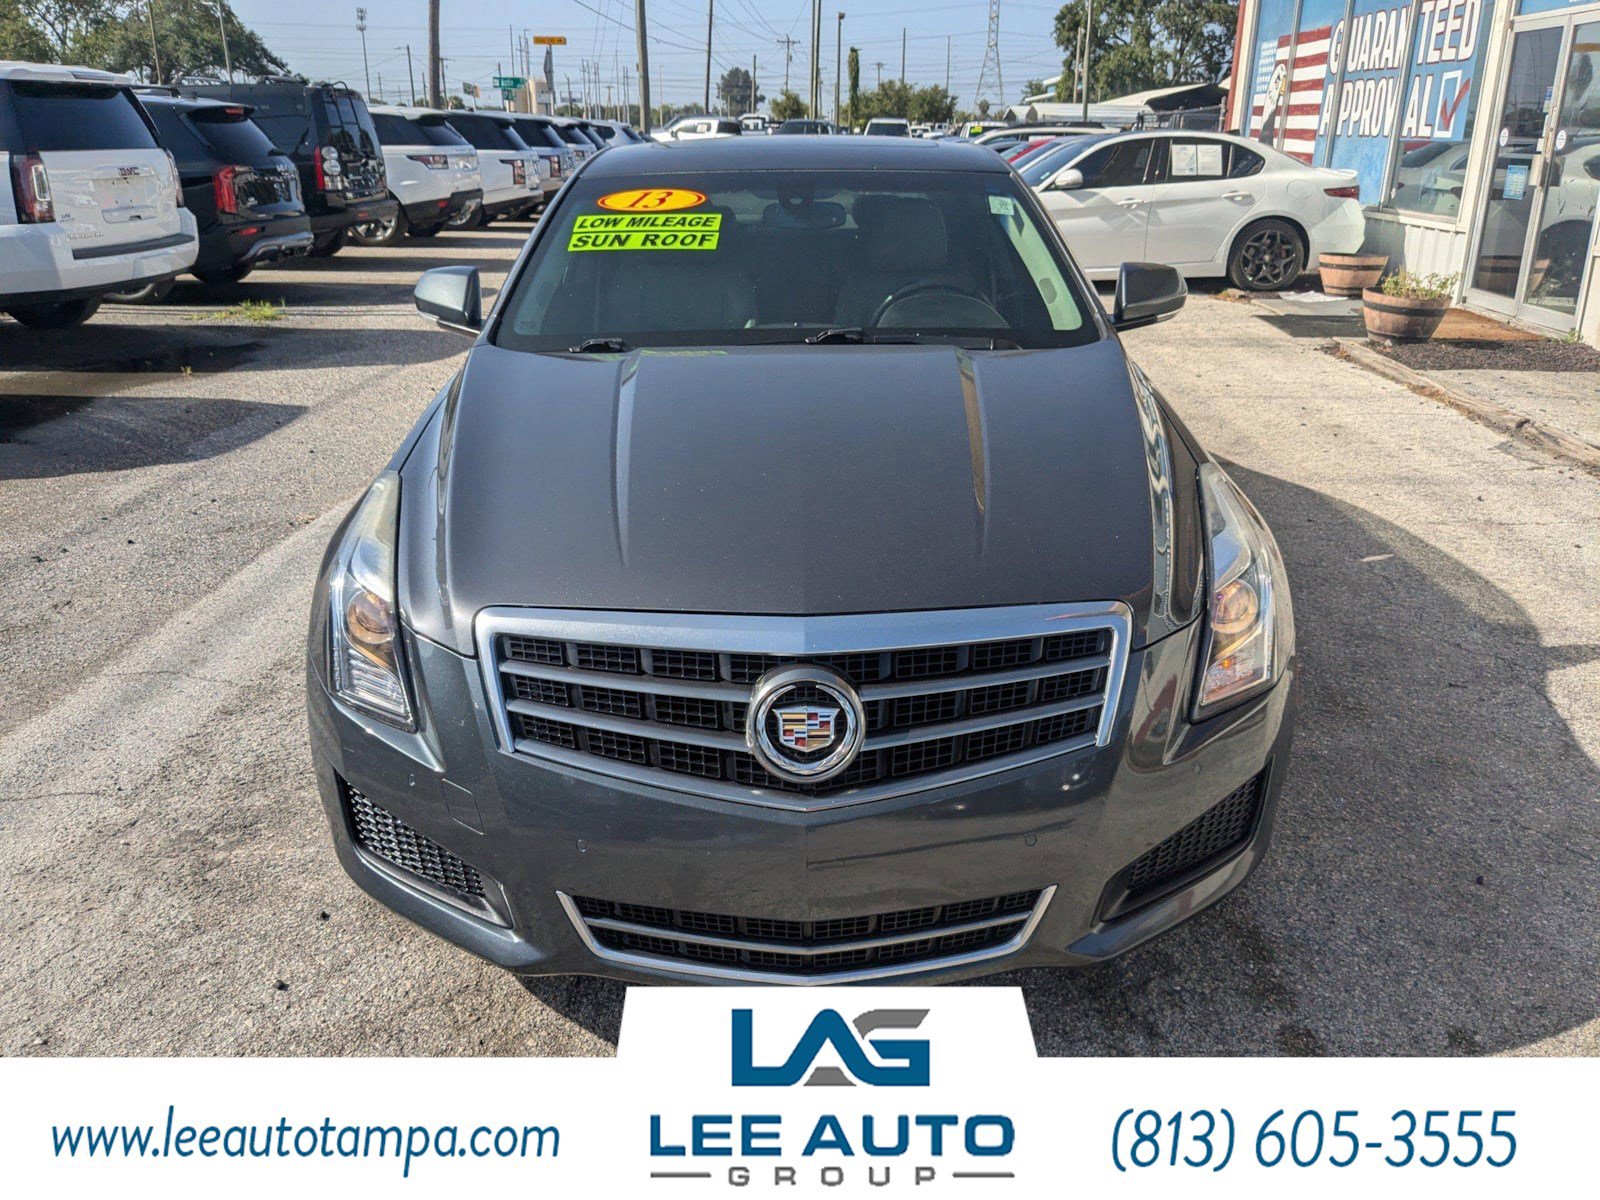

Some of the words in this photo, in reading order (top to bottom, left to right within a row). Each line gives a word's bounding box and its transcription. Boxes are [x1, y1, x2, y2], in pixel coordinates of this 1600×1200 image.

[1319, 74, 1434, 138] APPROVAL
[627, 191, 674, 209] 13
[577, 217, 626, 229] LOW
[625, 216, 717, 228] MILEAGE
[572, 234, 632, 248] SUN
[640, 233, 714, 247] ROOF
